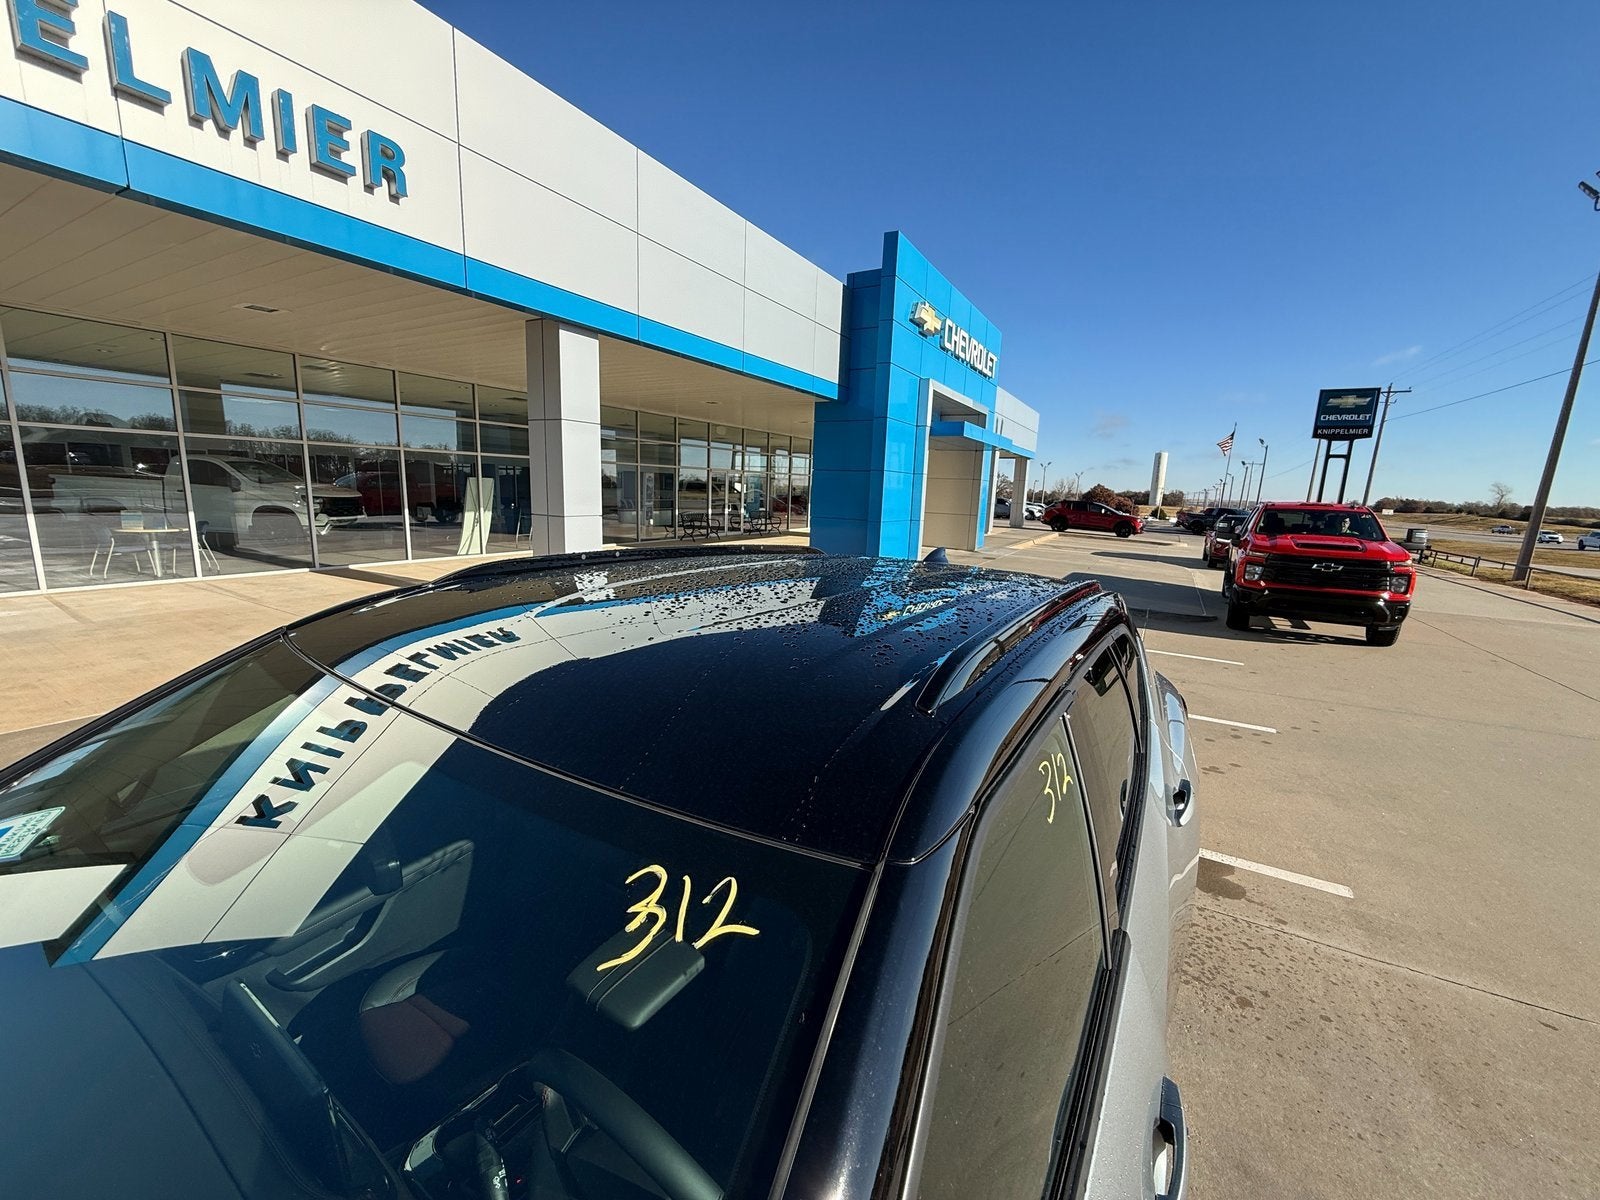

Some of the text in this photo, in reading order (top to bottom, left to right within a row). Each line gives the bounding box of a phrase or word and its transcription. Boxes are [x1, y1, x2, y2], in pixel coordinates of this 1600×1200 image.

[943, 318, 997, 379] CHEVROLET
[1038, 752, 1074, 825] 312
[596, 864, 761, 972] 312
